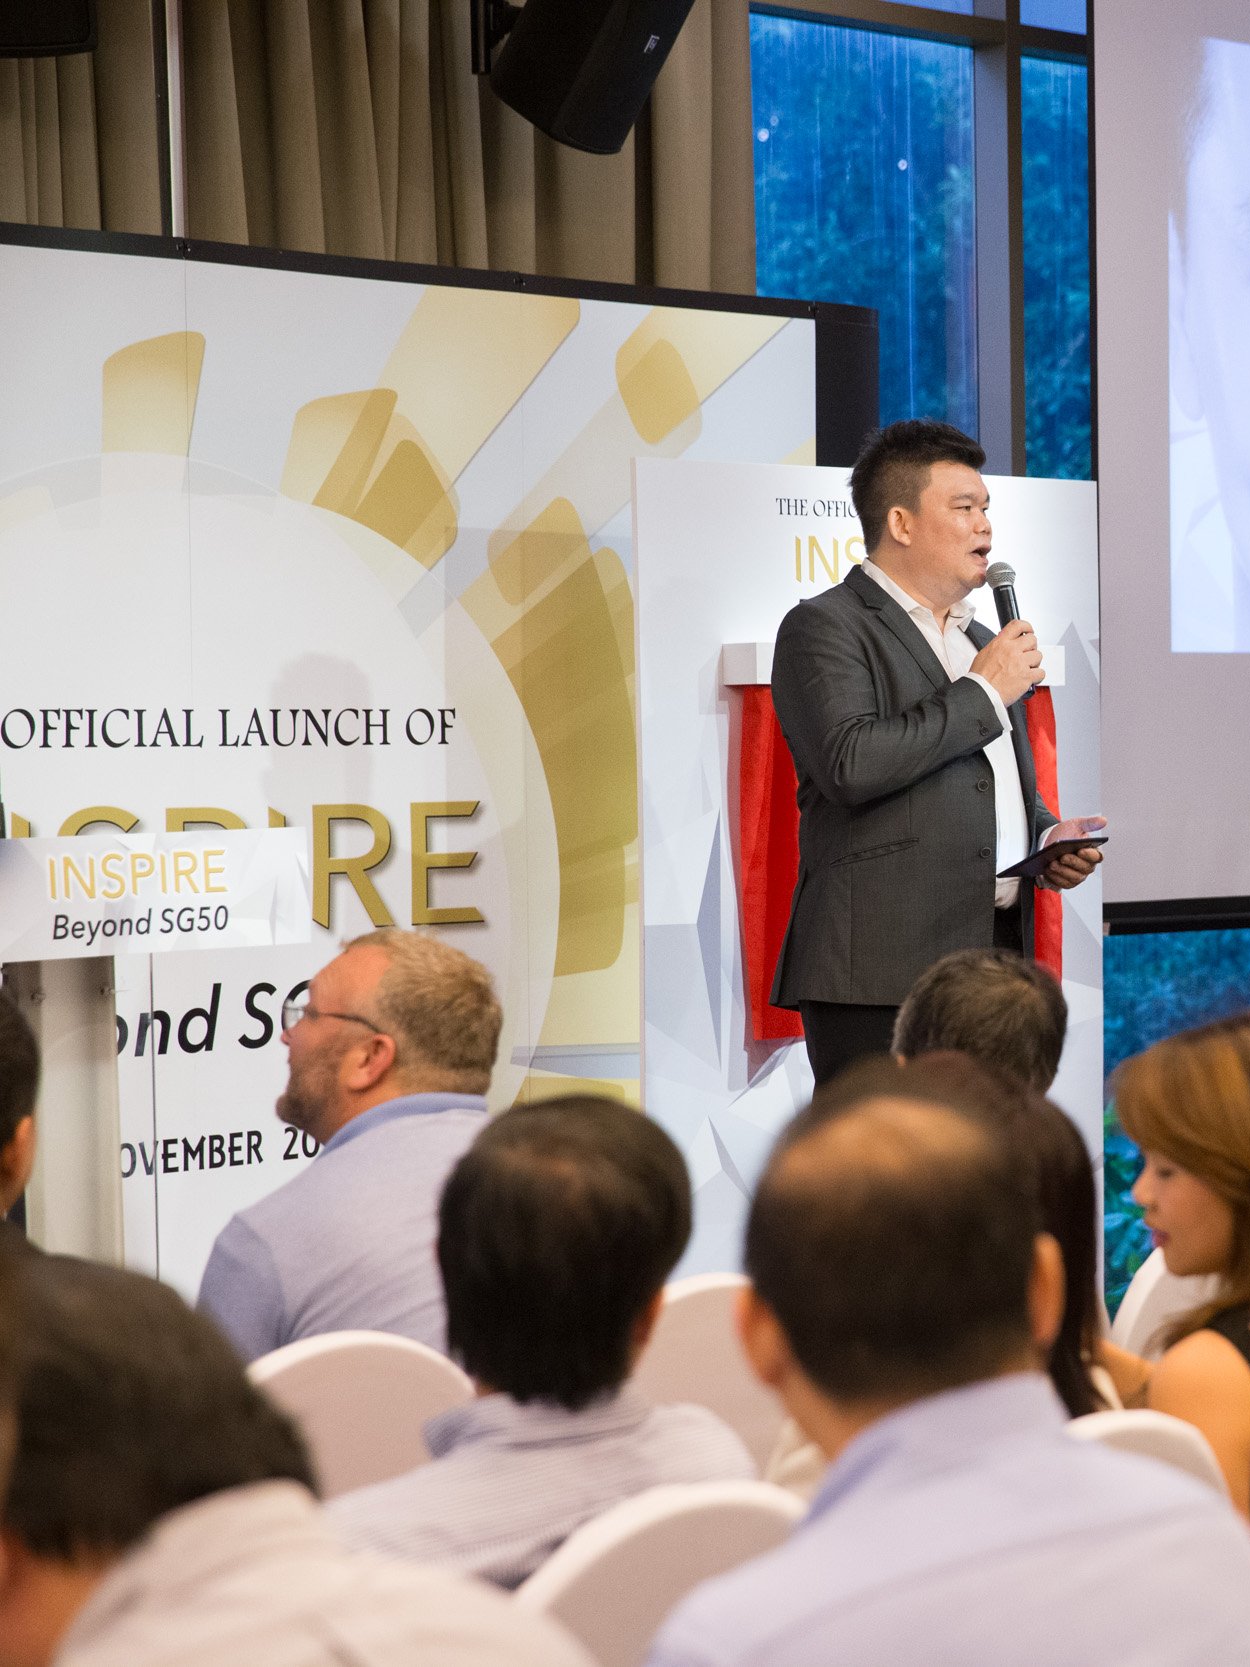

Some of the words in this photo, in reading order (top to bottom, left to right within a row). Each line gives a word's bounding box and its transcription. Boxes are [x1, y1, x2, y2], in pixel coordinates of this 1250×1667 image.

[776, 497, 808, 517] THE
[0, 707, 204, 749] OFFICIAL
[218, 707, 391, 747] LAUNCH
[405, 707, 456, 746] OF
[48, 849, 229, 901] INSPIRE
[52, 908, 152, 946] Beyond
[159, 905, 229, 934] SG50
